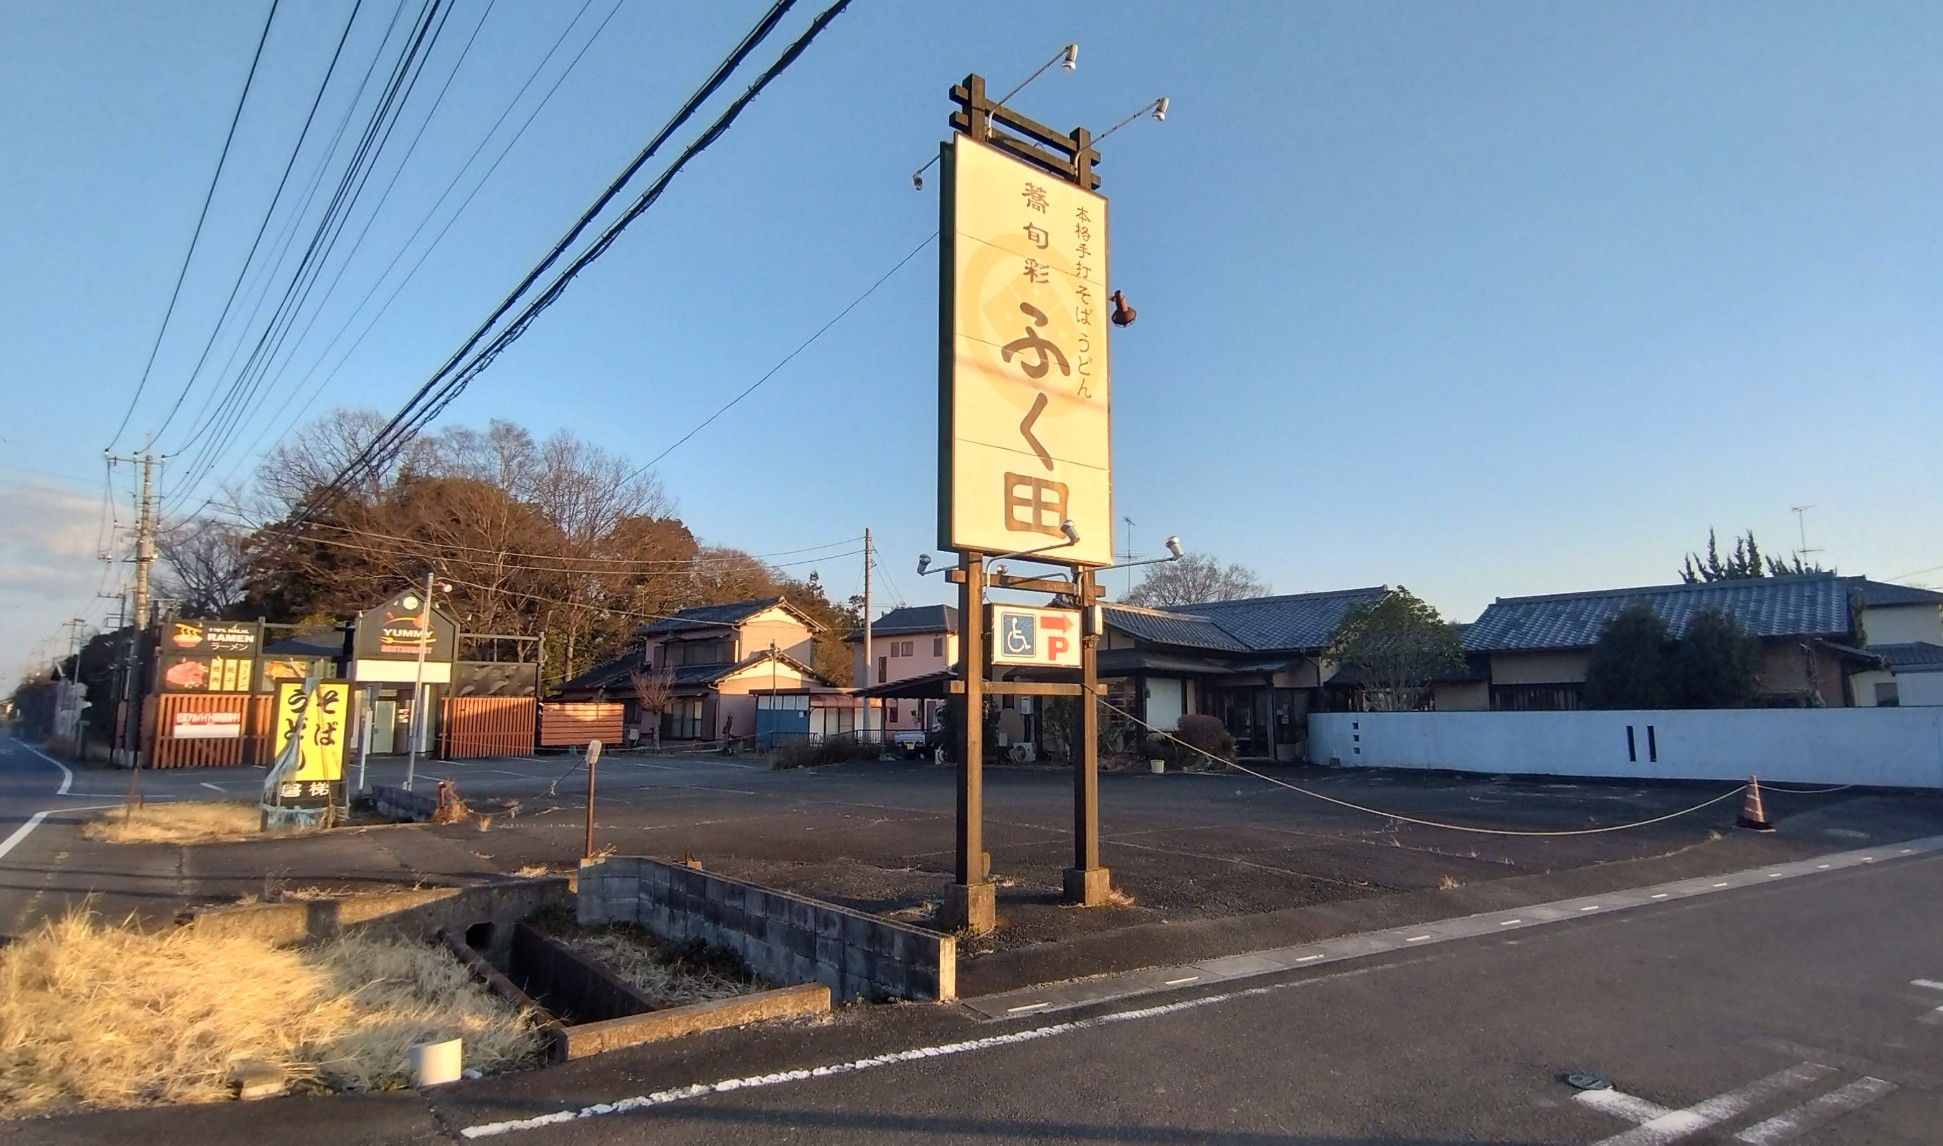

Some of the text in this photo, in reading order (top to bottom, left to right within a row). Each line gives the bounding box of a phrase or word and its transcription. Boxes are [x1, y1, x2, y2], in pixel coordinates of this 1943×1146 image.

[1021, 181, 1050, 284] 蕎旬彩
[1000, 301, 1071, 539] ふく田
[207, 633, 255, 643] RAMEN
[383, 628, 434, 638] YUMMY
[211, 642, 249, 651] ラーメン
[1048, 636, 1069, 661] P
[315, 689, 340, 746] そば
